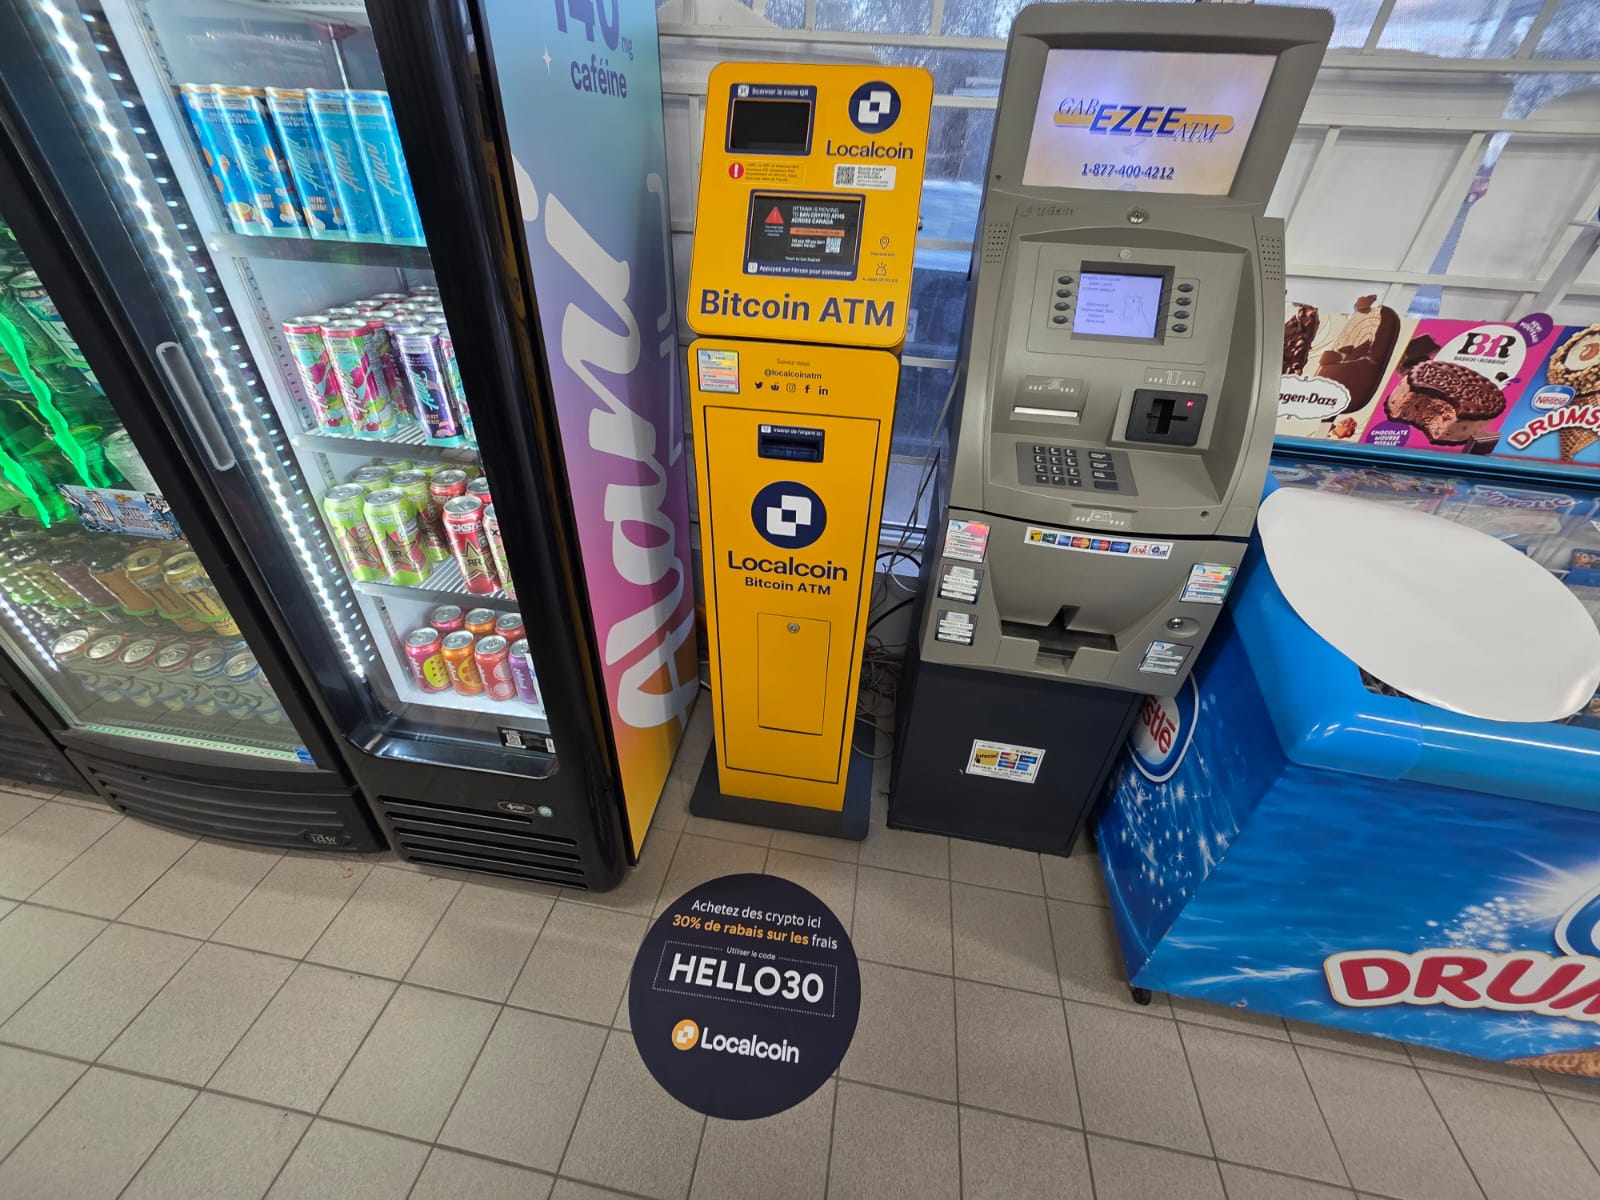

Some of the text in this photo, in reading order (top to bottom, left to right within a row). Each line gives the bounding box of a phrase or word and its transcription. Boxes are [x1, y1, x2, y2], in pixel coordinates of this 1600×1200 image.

[621, 37, 634, 61] mg
[570, 54, 628, 98] caféine
[1058, 97, 1220, 143] GAB EZEE ATM
[826, 140, 914, 160] Localcoin
[1081, 163, 1175, 180] 1-877-400-4212
[700, 288, 810, 322] Bitcoin
[818, 296, 895, 327] ATM
[764, 368, 822, 380] @localcoinatm
[511, 155, 699, 730] Alani
[1510, 406, 1600, 446] DRUMS
[727, 550, 848, 582] Localcoin
[744, 576, 831, 596] Bitcoin ATM
[691, 899, 822, 929] Achetez des crypto ici
[672, 914, 838, 950] 30% de rabais sur les frais
[726, 946, 776, 960] Utiliser le code
[668, 953, 824, 1004] HELLO30
[701, 1027, 800, 1064] Localcoin
